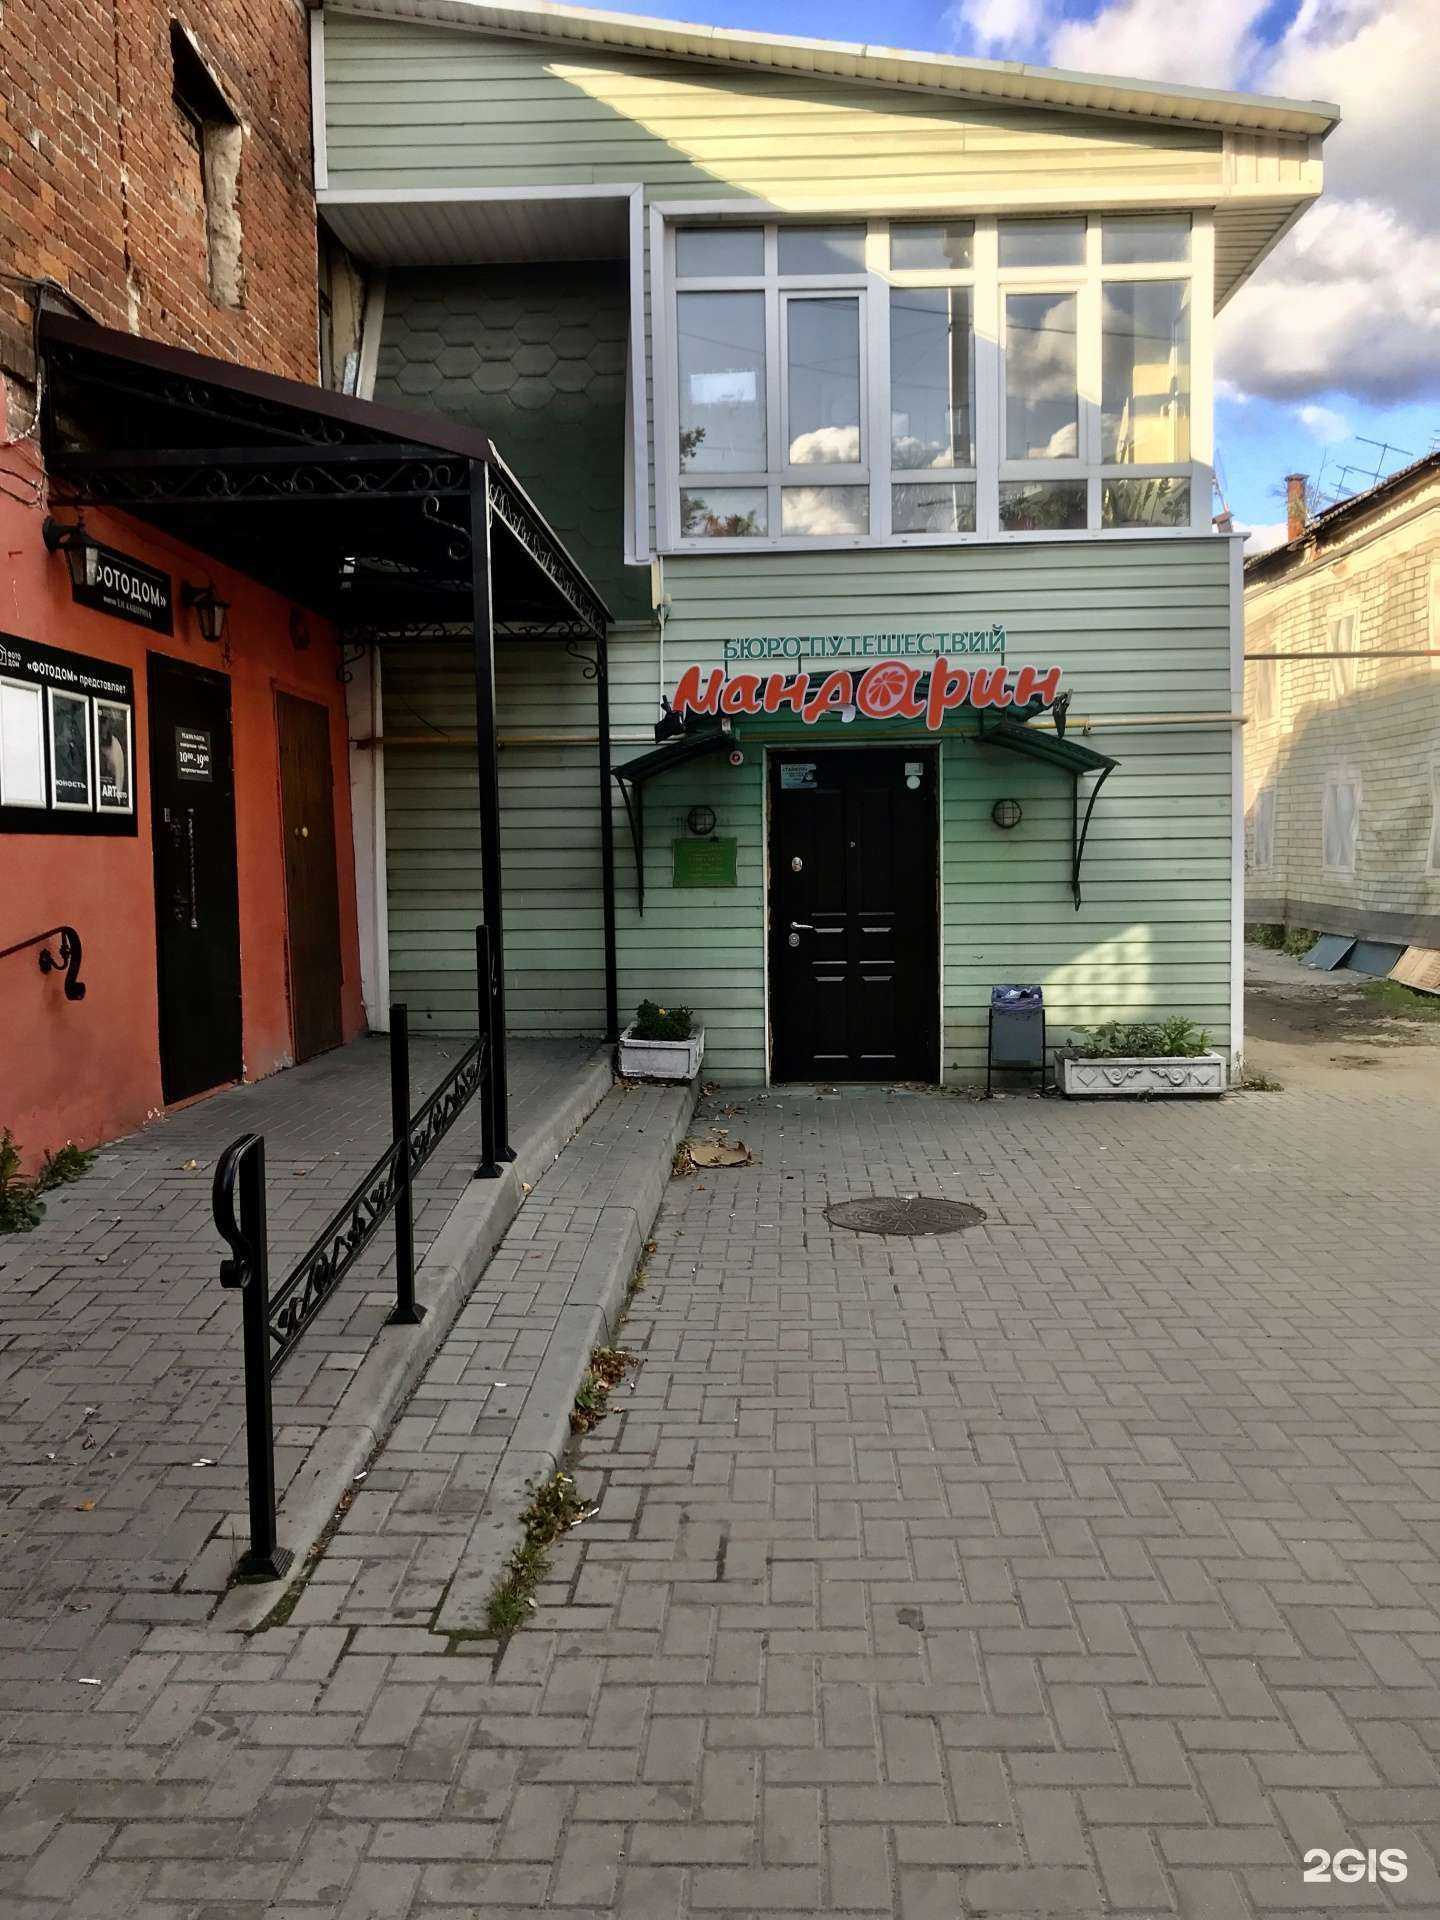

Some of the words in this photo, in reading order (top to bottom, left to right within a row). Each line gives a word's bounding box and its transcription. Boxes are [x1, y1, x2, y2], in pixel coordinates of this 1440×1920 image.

[723, 636, 801, 660] БЮРО
[810, 623, 1007, 657] ПУТЕШЕСТВИЙ
[27, 661, 78, 682] «ФОТОДОМ»
[79, 675, 126, 694] представляет
[671, 656, 1063, 731] Мандарин
